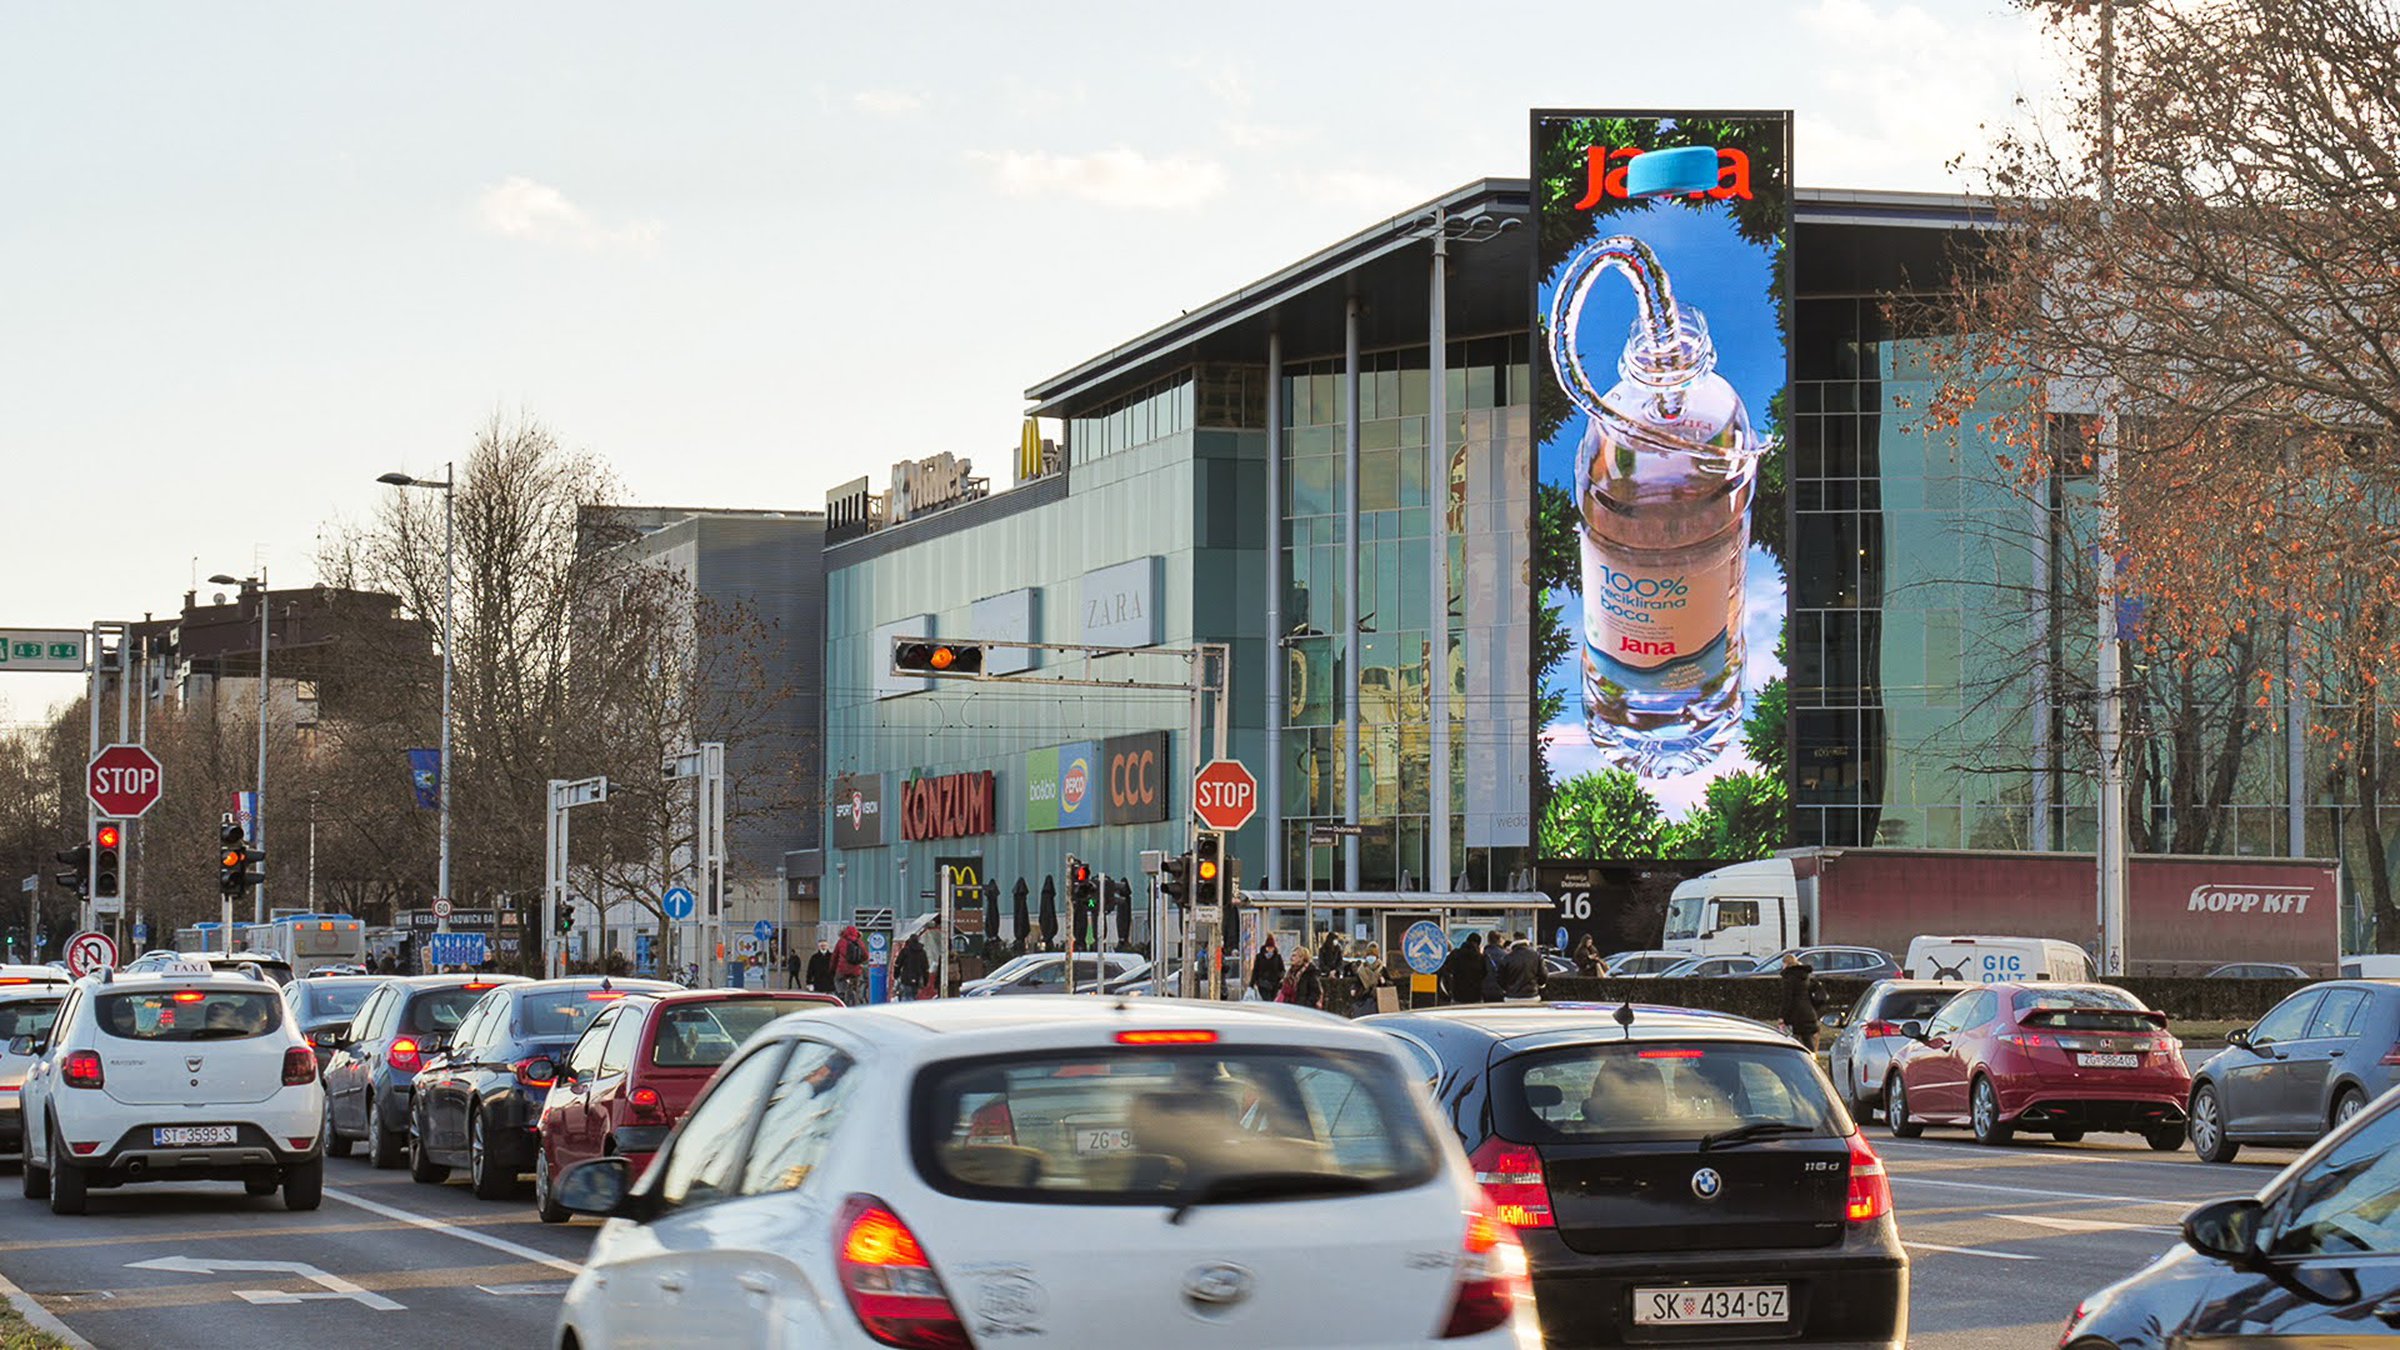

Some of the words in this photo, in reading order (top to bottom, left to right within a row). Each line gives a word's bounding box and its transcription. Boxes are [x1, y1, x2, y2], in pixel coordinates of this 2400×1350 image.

[1575, 146, 1754, 210] Jaa
[1600, 564, 1688, 598] 100%
[1088, 590, 1142, 629] ZARA
[1601, 595, 1655, 624] boca.
[1619, 636, 1677, 656] Jana
[95, 767, 155, 795] STOP
[1065, 776, 1085, 795] PEPCO
[1111, 750, 1154, 808] CCC
[901, 769, 991, 841] KONZUM
[1199, 782, 1250, 808] STOP
[1561, 880, 1591, 888] Dubrovnik
[1560, 892, 1591, 920] 16
[2187, 887, 2260, 913] KOPP
[2262, 894, 2311, 914] KFT
[448, 914, 482, 924] ANDWICH
[173, 964, 203, 972] TAXI
[1983, 955, 2020, 972] GIG
[163, 1129, 177, 1143] ST
[1090, 1131, 1109, 1149] ZG
[1653, 1293, 1680, 1319] SK
